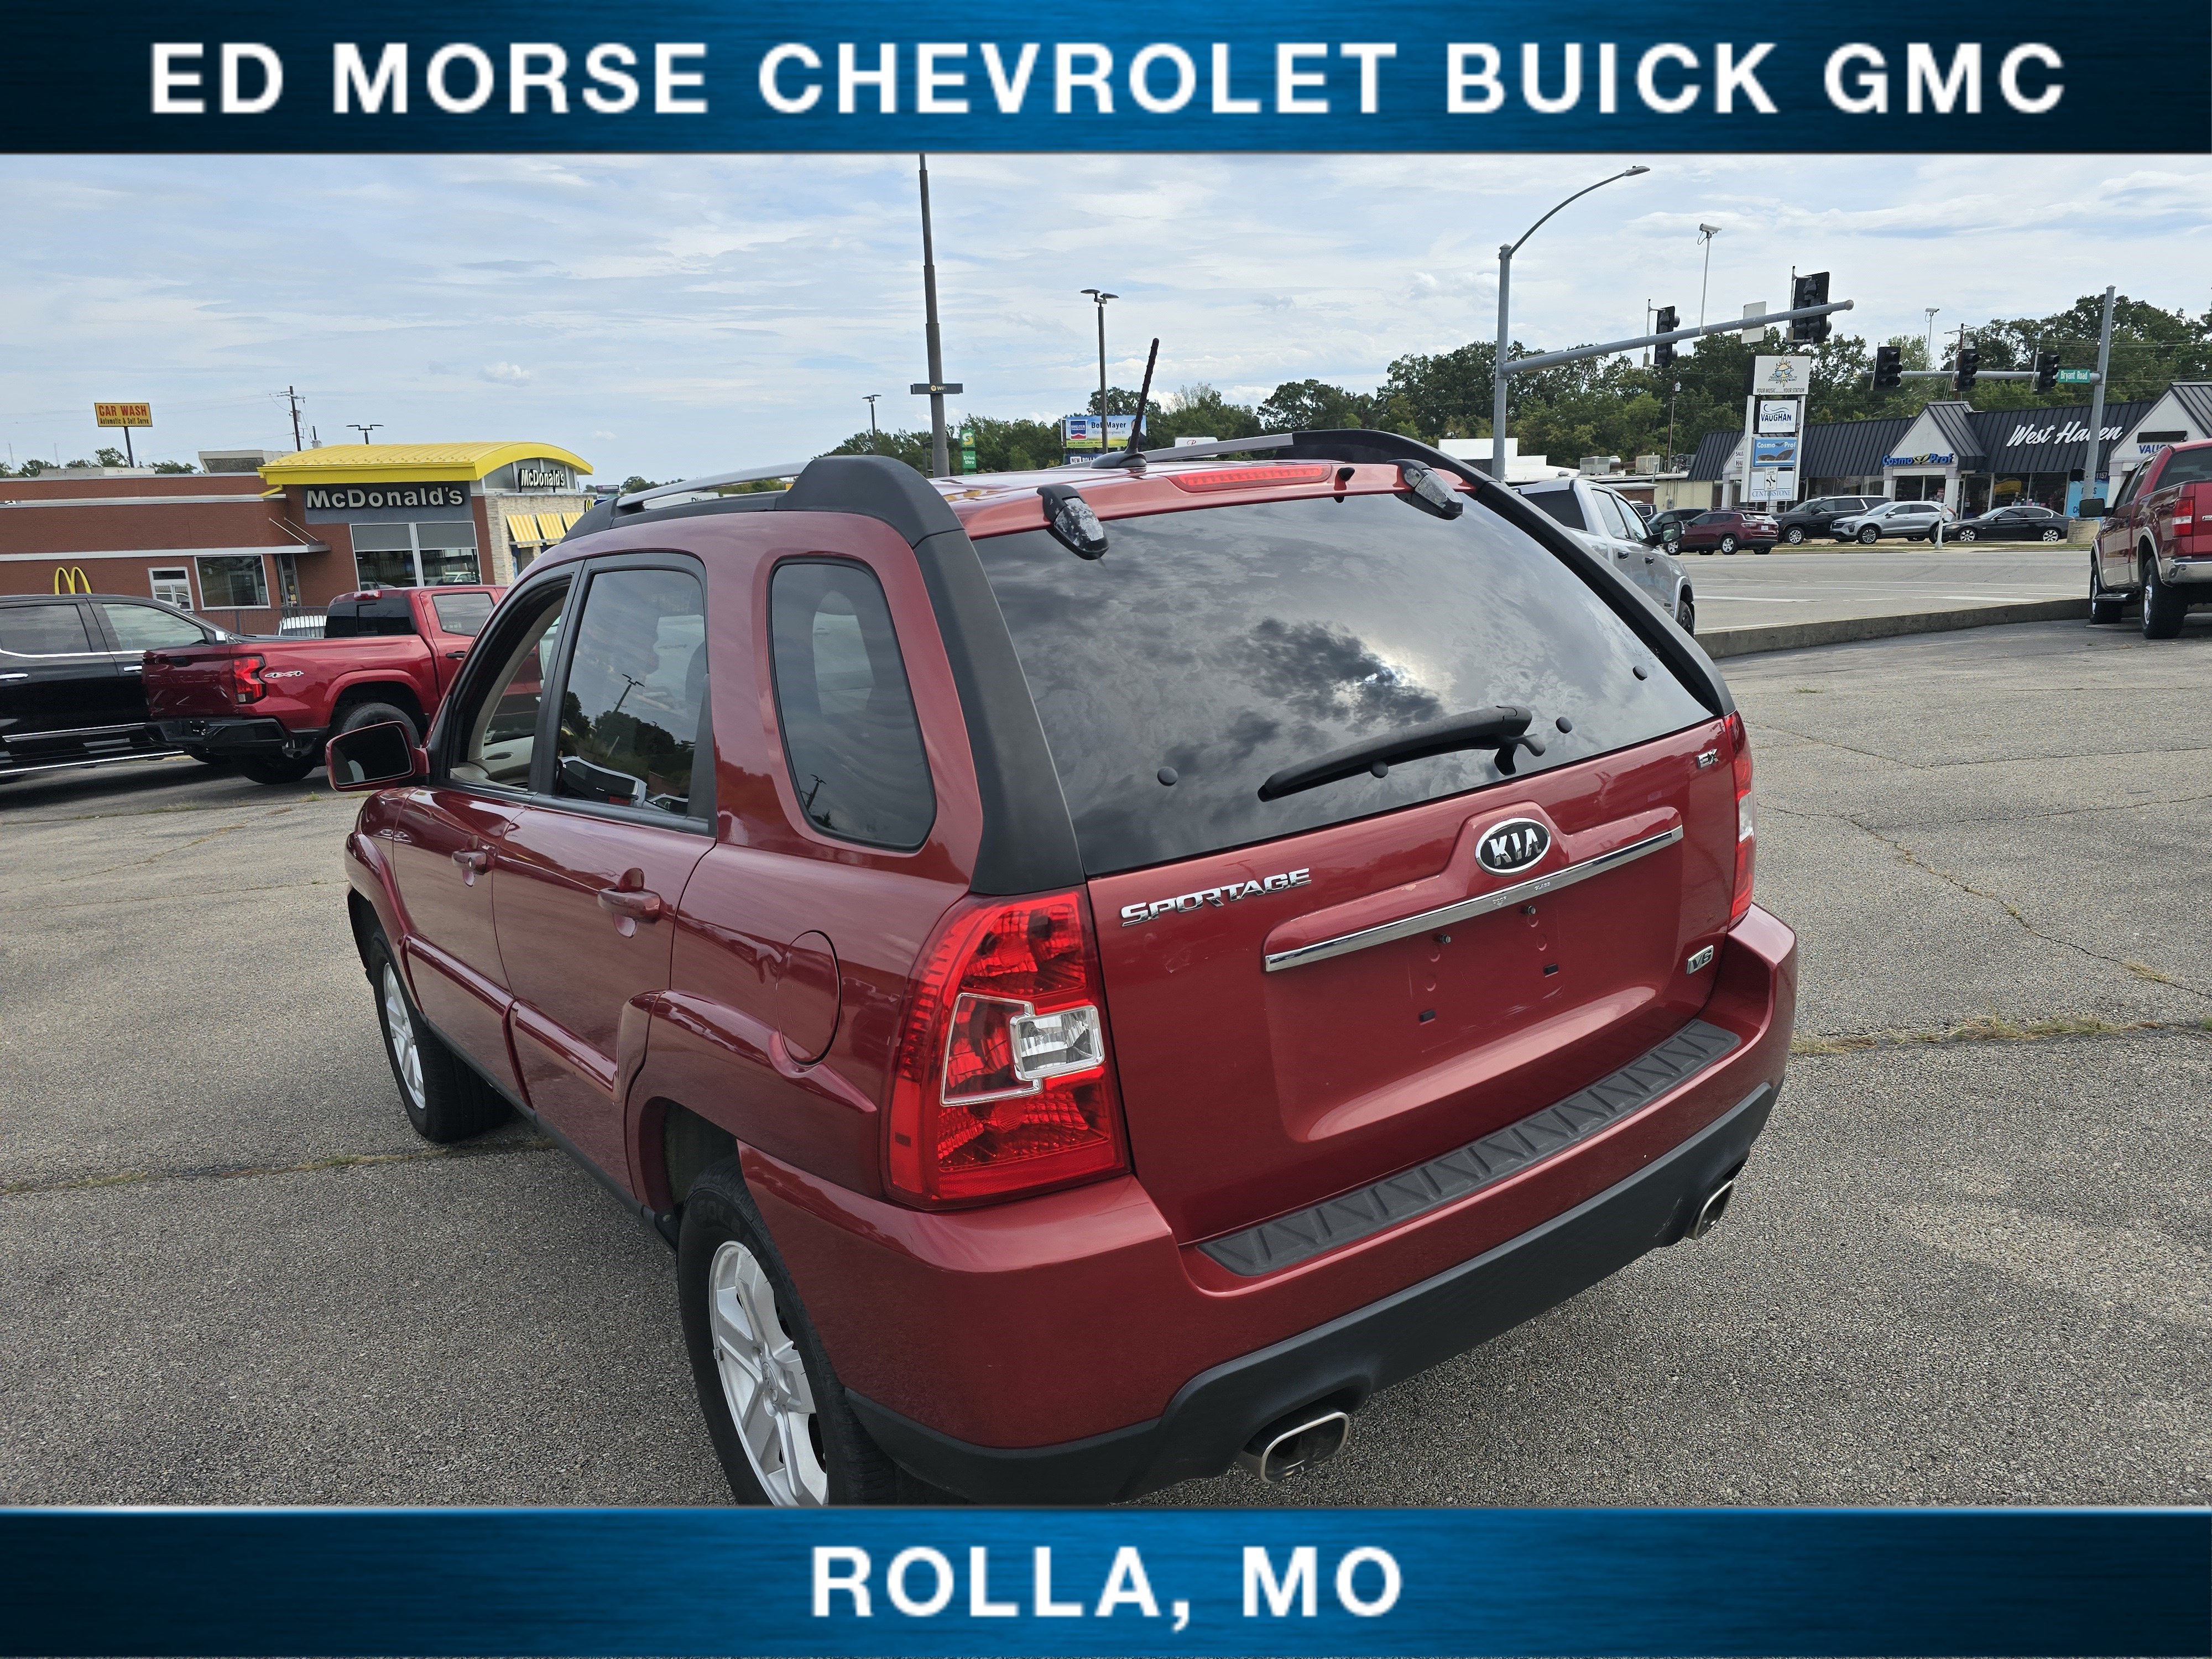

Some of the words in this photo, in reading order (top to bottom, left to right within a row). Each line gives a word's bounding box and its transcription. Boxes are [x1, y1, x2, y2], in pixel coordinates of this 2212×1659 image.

[2060, 370, 2075, 382] Bryant
[2077, 371, 2088, 380] Road
[98, 405, 117, 416] CAR
[120, 405, 147, 416] WASH
[1761, 413, 1792, 422] VAUGHAN
[2006, 424, 2056, 447] West
[2054, 421, 2123, 445] Haen
[1882, 455, 1913, 465] Cosmo
[1929, 453, 1954, 463] Prof
[521, 469, 565, 487] McDonald's
[307, 487, 463, 508] McDonald's
[1696, 748, 1719, 769] EX
[1488, 827, 1542, 867] KIA
[1120, 868, 1312, 927] SPORTAGE
[1692, 949, 1712, 970] V6
